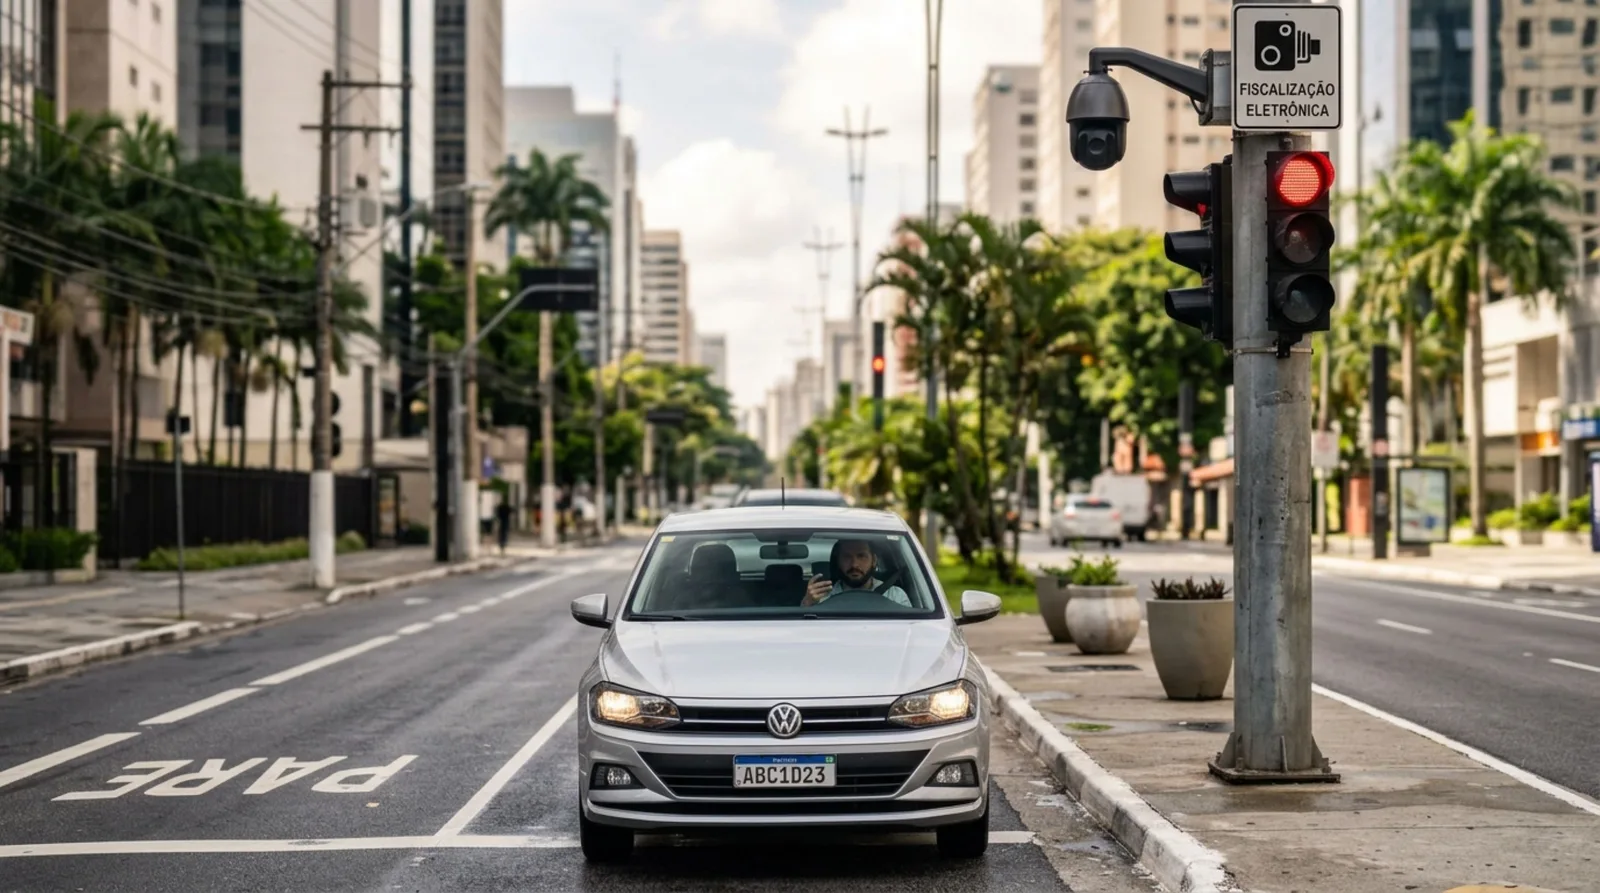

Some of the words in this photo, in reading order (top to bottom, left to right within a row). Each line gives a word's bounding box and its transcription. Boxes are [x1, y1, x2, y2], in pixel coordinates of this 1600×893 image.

[1239, 80, 1335, 99] FISCALIZAÇÃO
[1246, 100, 1330, 117] ELETRÔNICA
[770, 705, 800, 736] VW
[51, 754, 419, 801] PARE
[743, 766, 825, 784] ABC1D23
